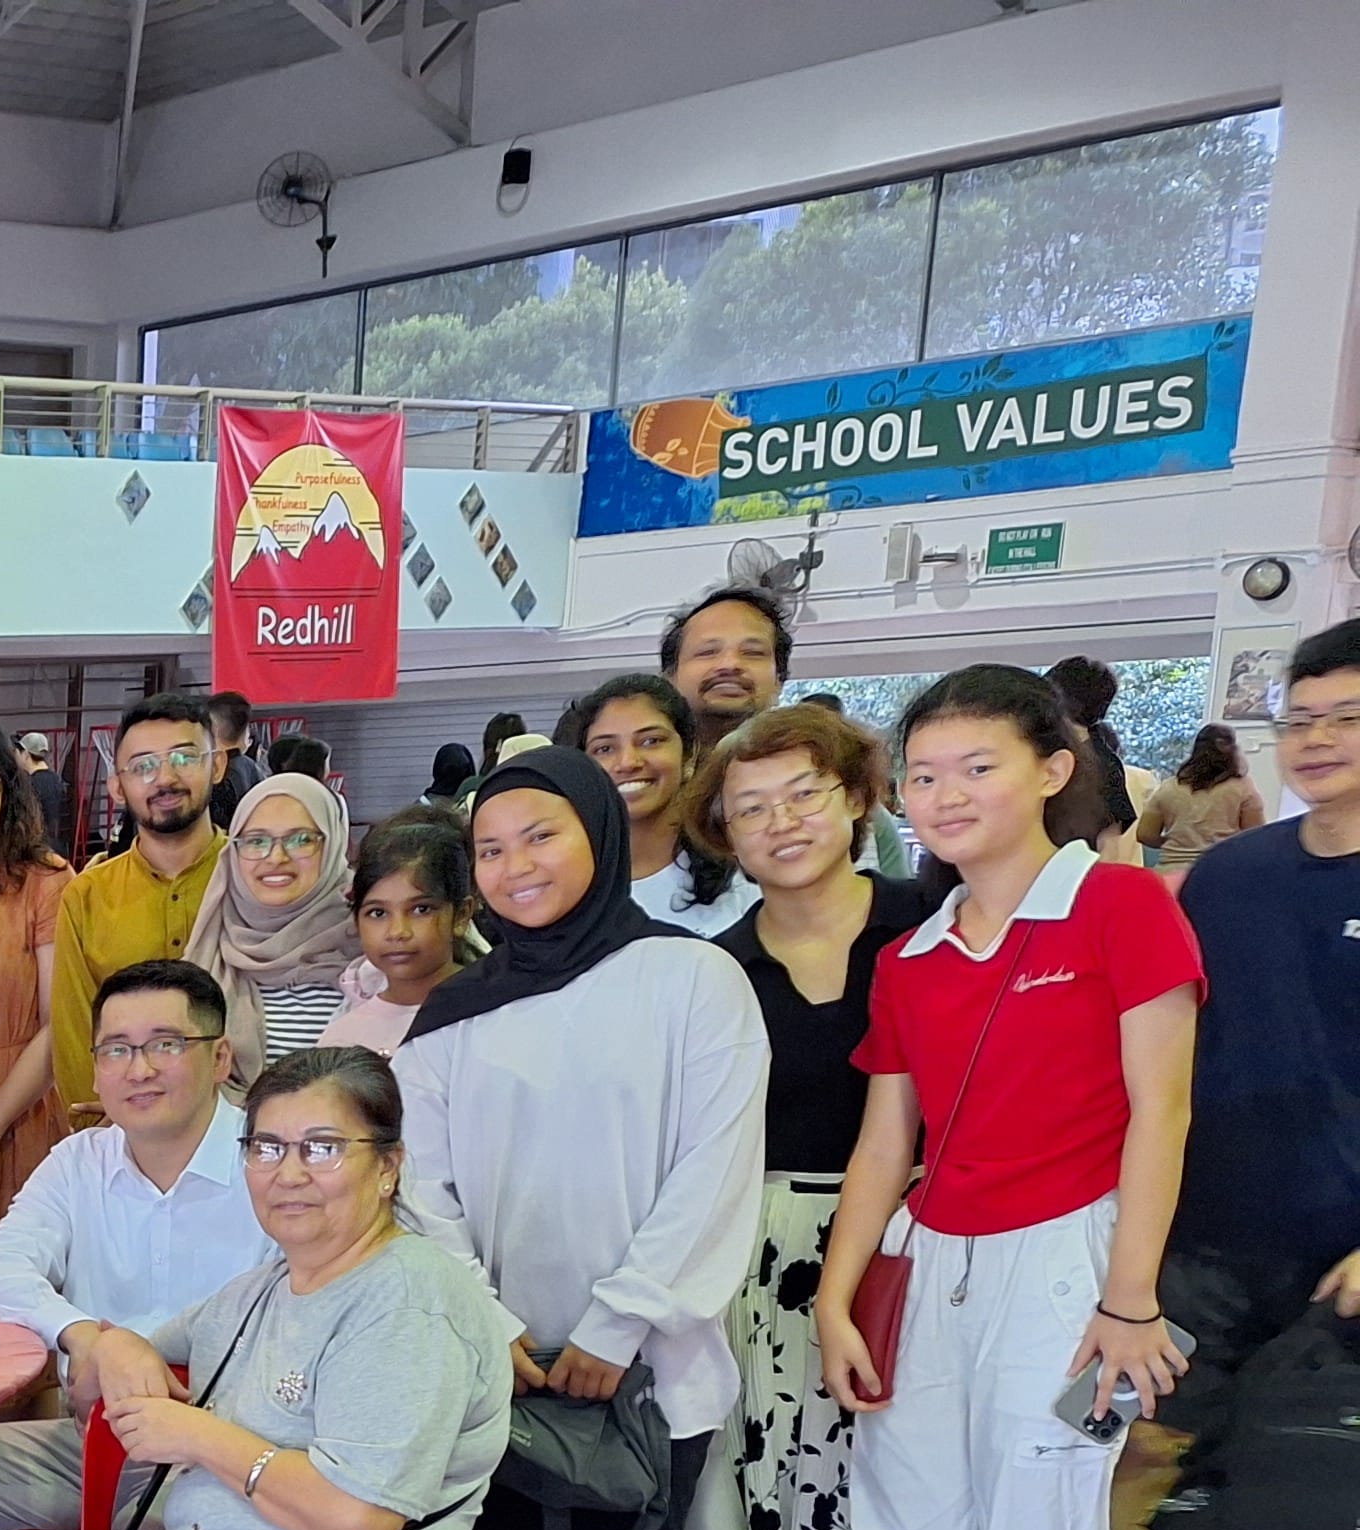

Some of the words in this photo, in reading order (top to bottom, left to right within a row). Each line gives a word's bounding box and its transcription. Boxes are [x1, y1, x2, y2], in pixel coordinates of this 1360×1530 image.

[721, 408, 939, 480] SCHOOL
[954, 375, 1195, 453] VALUES
[295, 471, 361, 487] Purposefulness
[272, 519, 311, 536] Empathy
[257, 604, 355, 646] Redhill
